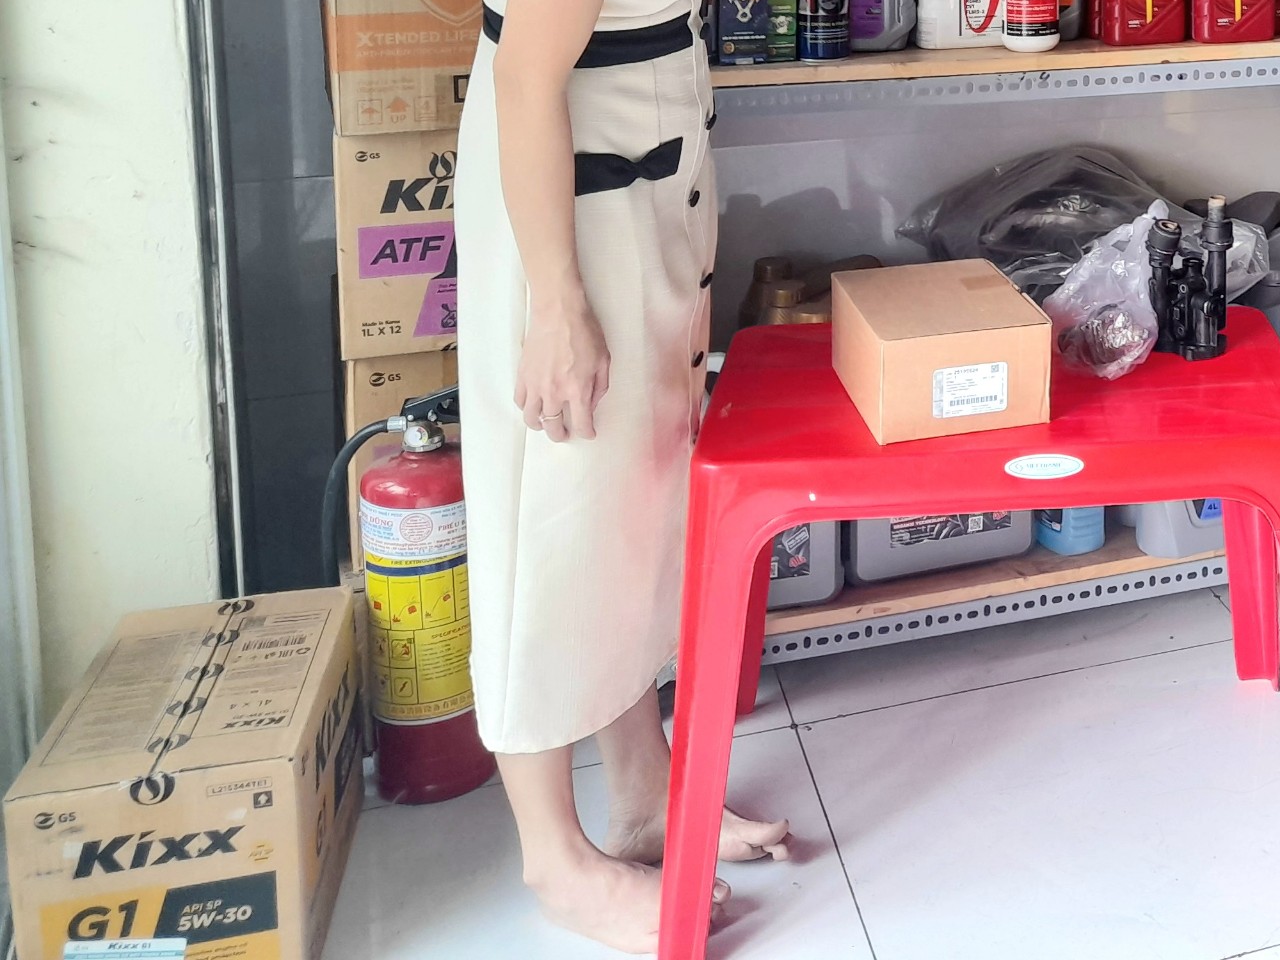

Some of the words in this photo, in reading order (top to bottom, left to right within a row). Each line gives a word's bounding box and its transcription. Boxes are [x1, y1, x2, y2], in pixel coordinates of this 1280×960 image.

[355, 30, 440, 48] XTENDED
[445, 29, 479, 41] LIFE
[369, 152, 381, 160] GS
[380, 177, 454, 214] Ki
[370, 235, 446, 266] ATF
[362, 328, 373, 337] 1L
[389, 325, 402, 334] 12
[388, 373, 402, 382] GS
[221, 716, 286, 730] Kixx
[58, 811, 77, 824] GS
[72, 824, 247, 880] Kixx
[182, 902, 203, 914] API
[206, 899, 223, 910] SP
[67, 899, 139, 941] G1
[177, 904, 253, 932] 5W-30
[107, 942, 139, 950] Kixx
